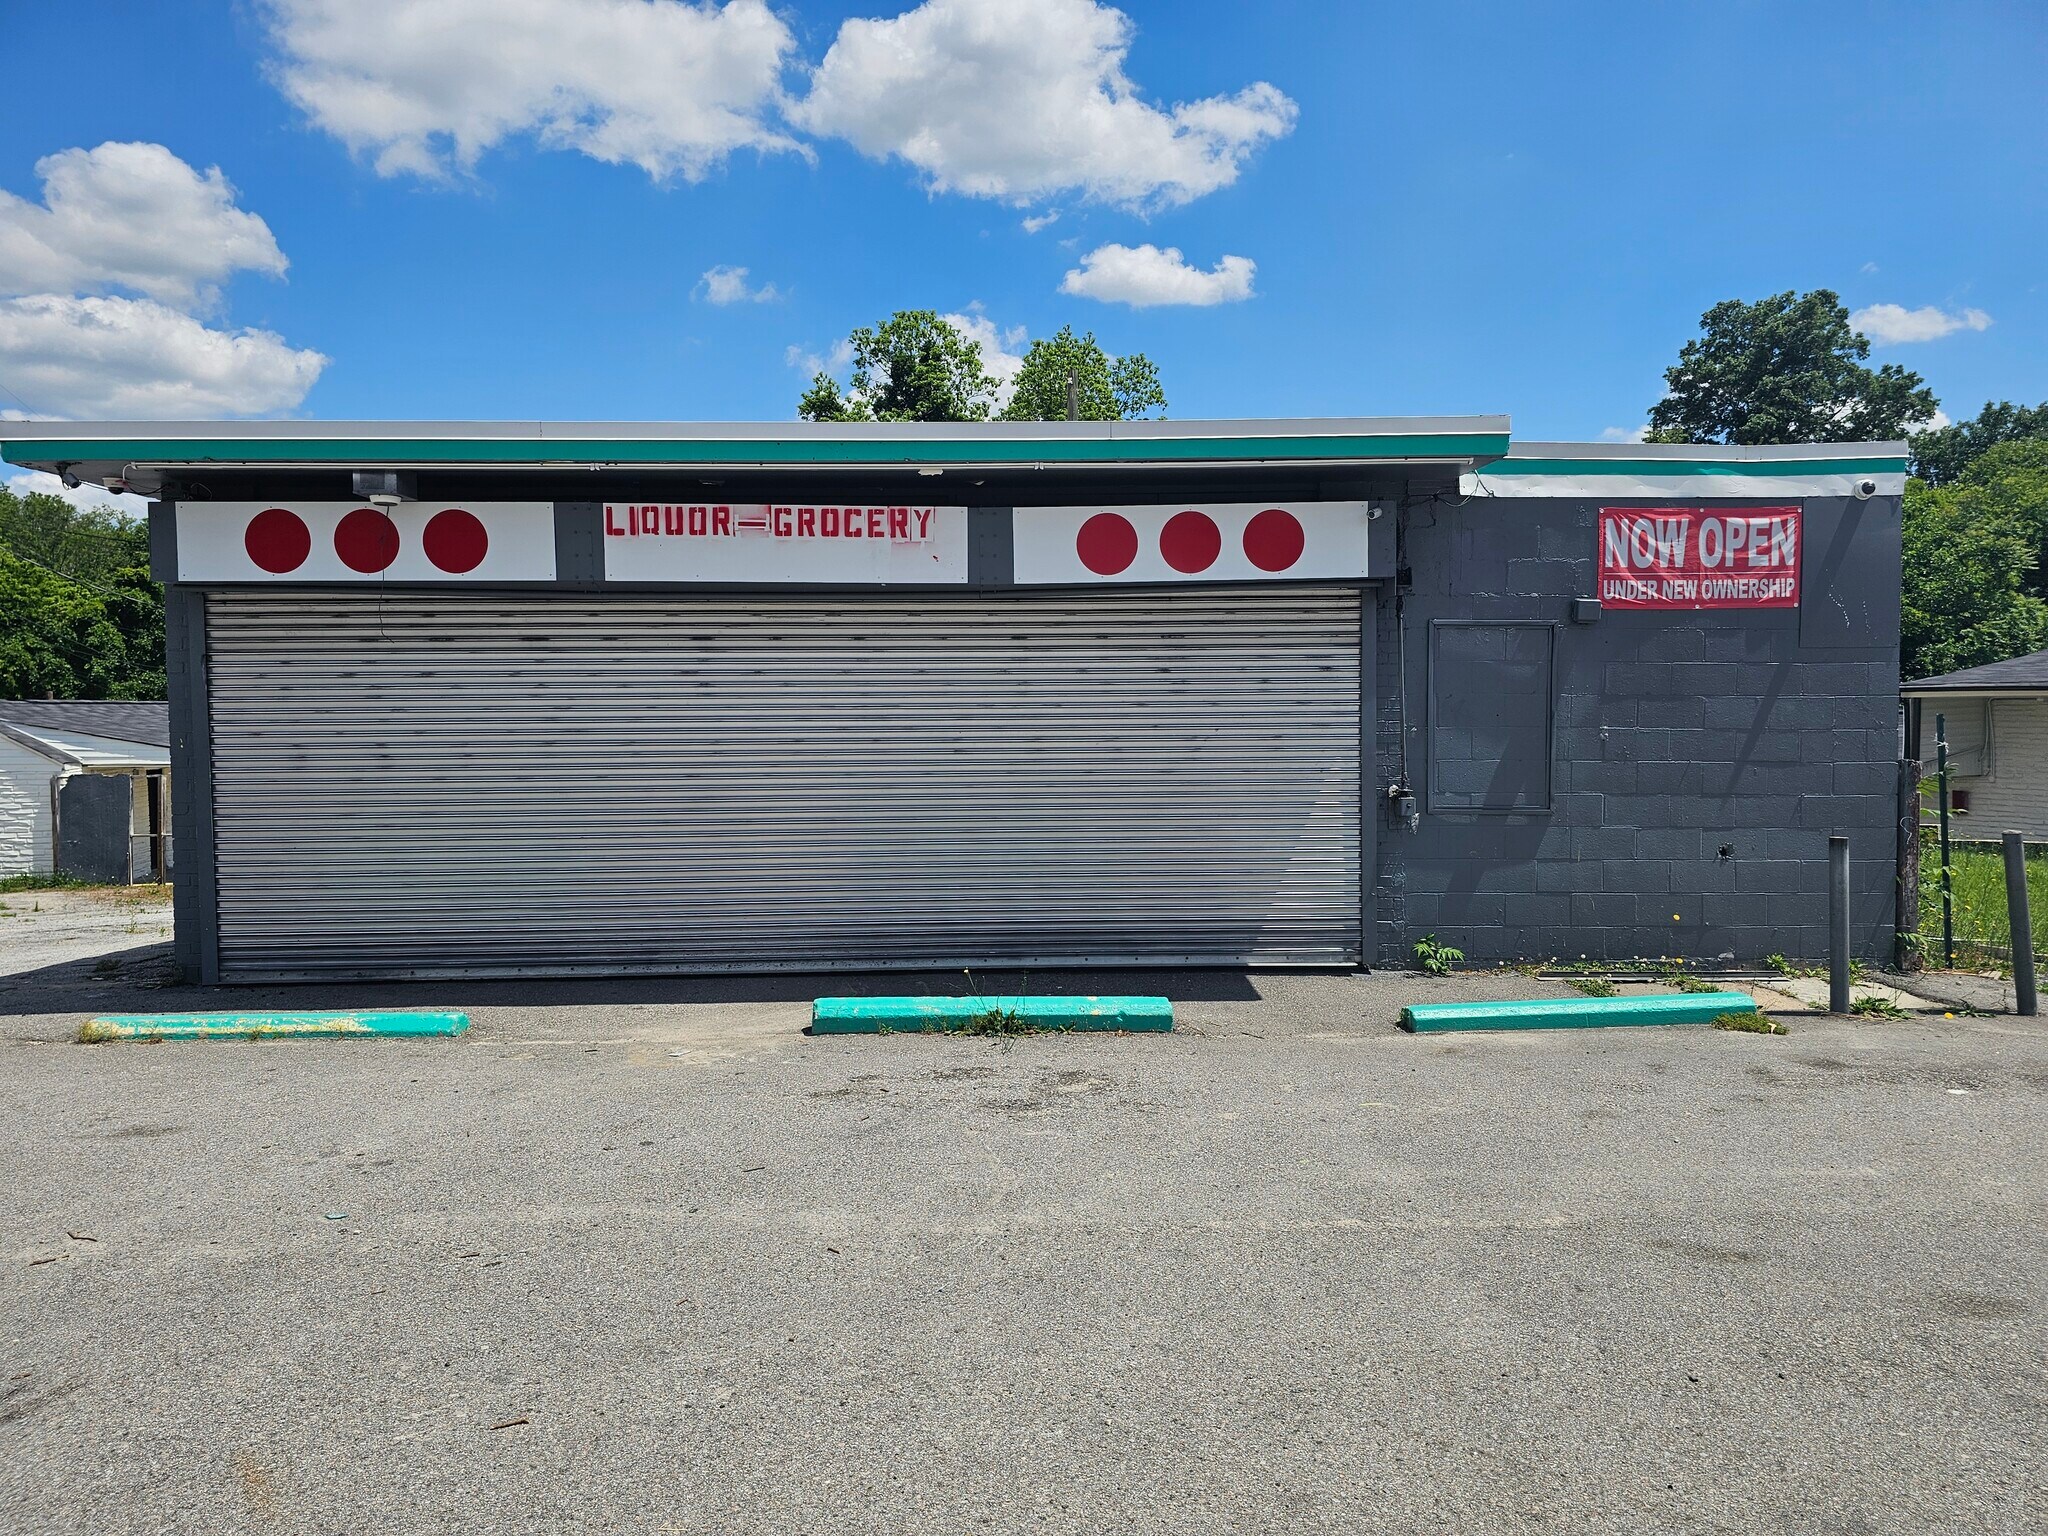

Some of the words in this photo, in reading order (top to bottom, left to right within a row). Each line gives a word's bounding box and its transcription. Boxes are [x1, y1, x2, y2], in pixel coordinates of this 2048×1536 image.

[1604, 517, 1690, 569] NOW
[1698, 516, 1796, 568] OPEN
[1603, 579, 1659, 600] UNDER
[1661, 579, 1699, 600] NEW
[1701, 577, 1796, 600] OWNERSHIP
